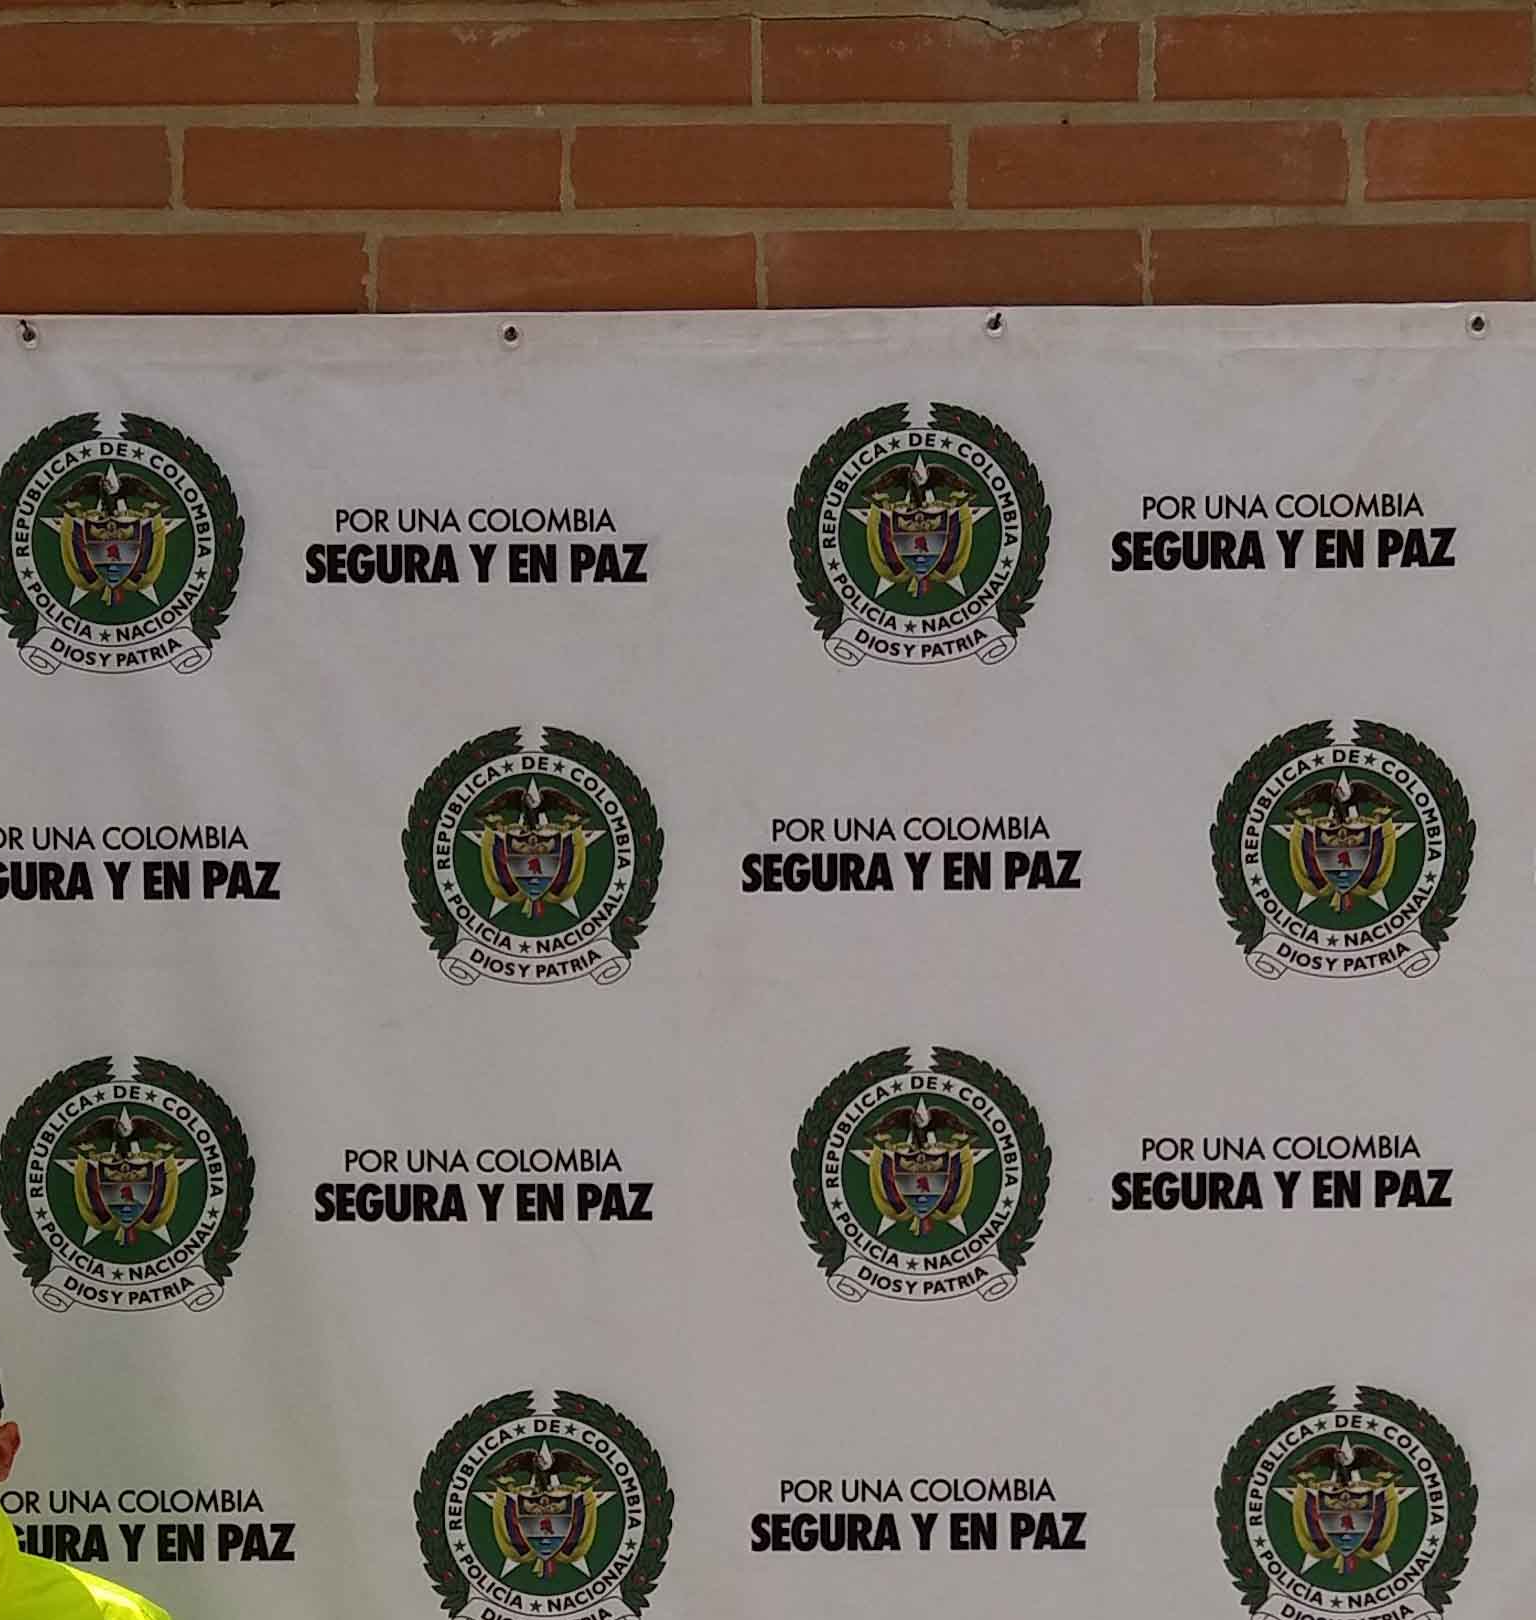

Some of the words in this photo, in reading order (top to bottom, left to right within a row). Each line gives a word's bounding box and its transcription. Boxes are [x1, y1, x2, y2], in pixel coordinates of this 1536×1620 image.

[1142, 495, 1198, 521] POR
[1204, 493, 1270, 521] UNA
[1275, 491, 1425, 520] COLOMBIA
[1111, 529, 1267, 573] SEGURA
[1275, 528, 1305, 570] Y
[1315, 527, 1366, 569] EN
[1377, 526, 1458, 569] PAZ
[522, 757, 549, 771] DE
[571, 767, 631, 869] COLOMBIA
[536, 887, 623, 955] NACIONAL
[536, 950, 602, 979] PATRIA
[911, 1077, 937, 1090] DE
[959, 1086, 1019, 1187] COLOMBIA
[344, 1148, 400, 1174] POR
[406, 1147, 471, 1174] UNA
[475, 1147, 623, 1174] COLOMBIA
[314, 1181, 469, 1223] SEGURA
[476, 1182, 506, 1223] Y
[515, 1181, 565, 1223] EN
[576, 1181, 655, 1222] PAZ
[923, 1205, 1010, 1272] NACIONAL
[923, 1267, 989, 1296] PATRIA
[780, 1479, 835, 1504] POR
[841, 1477, 904, 1504] UNA
[909, 1477, 1057, 1503] COLOMBIA
[1335, 1415, 1362, 1429] DE
[1384, 1425, 1444, 1526] COLOMBIA
[750, 1512, 902, 1553] SEGURA
[909, 1511, 940, 1552] Y
[949, 1511, 998, 1551] EN
[1009, 1511, 1088, 1551] PAZ
[1348, 1543, 1436, 1610] NACIONAL
